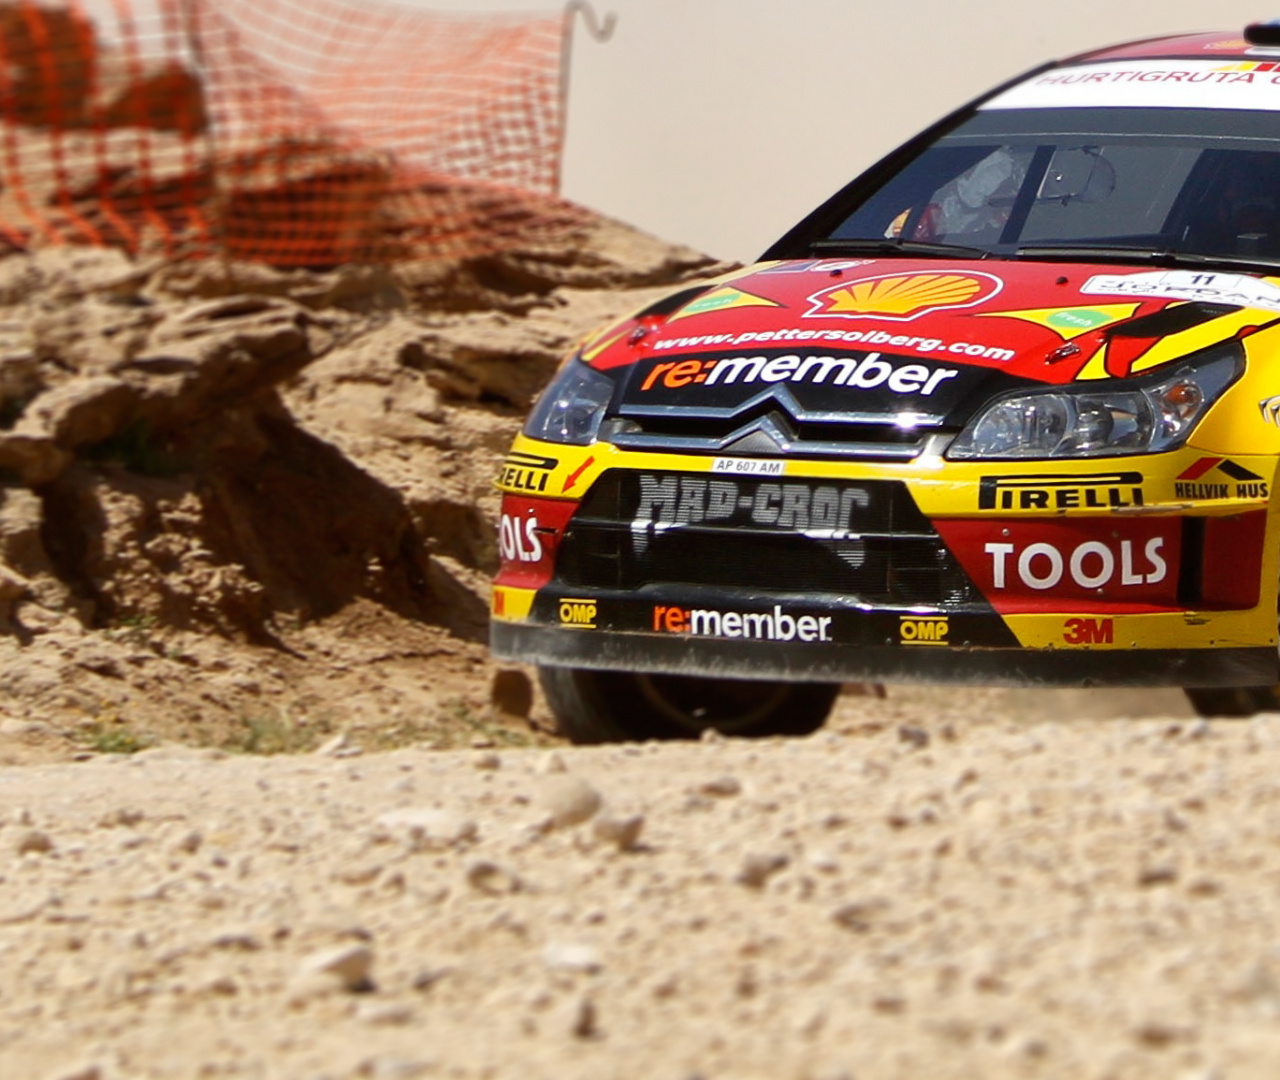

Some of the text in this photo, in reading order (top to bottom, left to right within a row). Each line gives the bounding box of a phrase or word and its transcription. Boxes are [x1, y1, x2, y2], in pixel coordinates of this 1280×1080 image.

[1036, 70, 1255, 88] HURTIGRUTA
[1191, 274, 1216, 286] 11
[1054, 312, 1092, 327] fresh
[653, 328, 1015, 362] www.pettersolberg.com
[641, 352, 958, 396] re:member
[716, 459, 781, 474] AP 607 AM
[978, 471, 1144, 509] PIRELLI
[1175, 481, 1268, 500] HELLVIK HUS
[631, 474, 869, 560] MAD-CROC
[501, 514, 542, 562] OLS
[984, 536, 1167, 591] TOOLS
[559, 603, 597, 623] OMP
[653, 604, 833, 642] re:member
[900, 620, 949, 641] OMP
[1063, 618, 1114, 645] 3M
